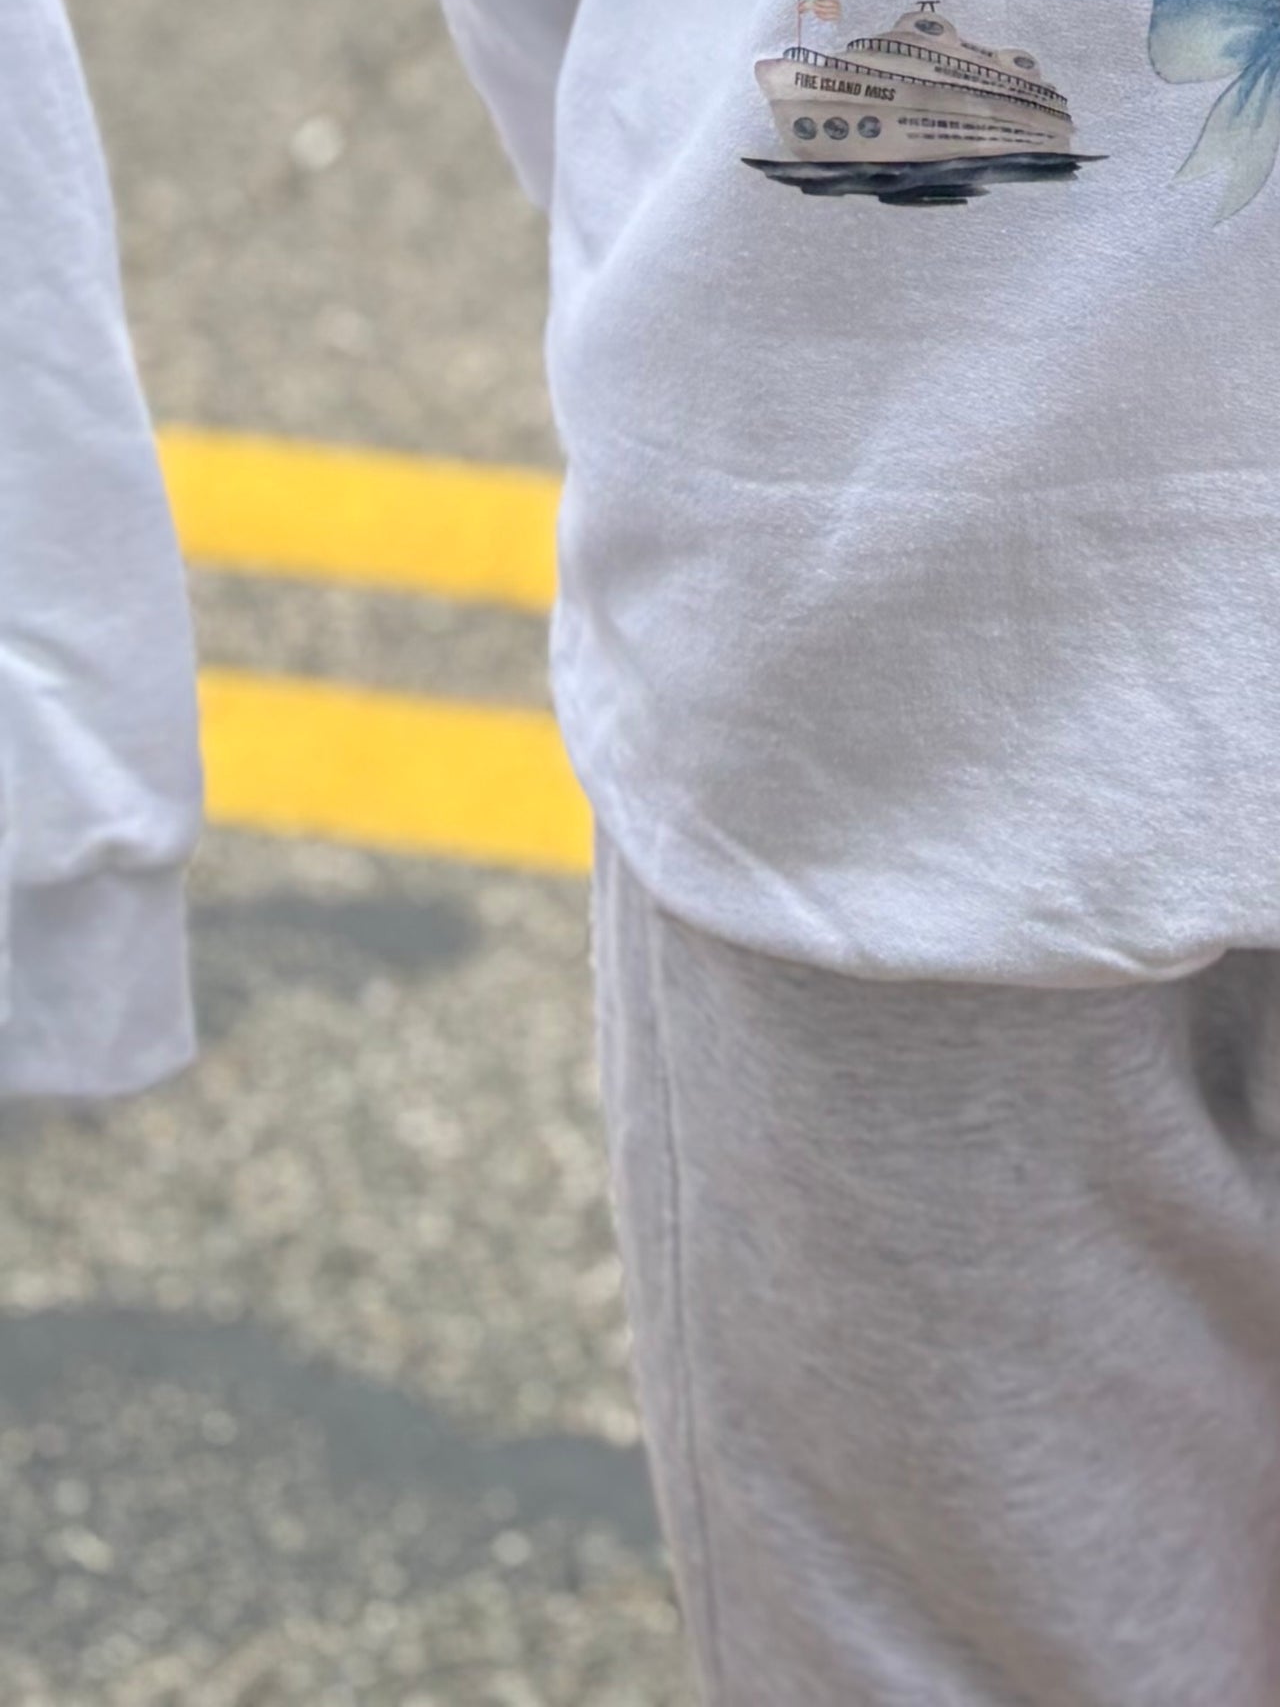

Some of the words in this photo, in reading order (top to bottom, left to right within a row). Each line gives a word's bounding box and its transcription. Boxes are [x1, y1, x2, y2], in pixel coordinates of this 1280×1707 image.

[794, 71, 818, 90] FIRE
[820, 77, 862, 96] ISLAND
[864, 84, 897, 102] MISS
